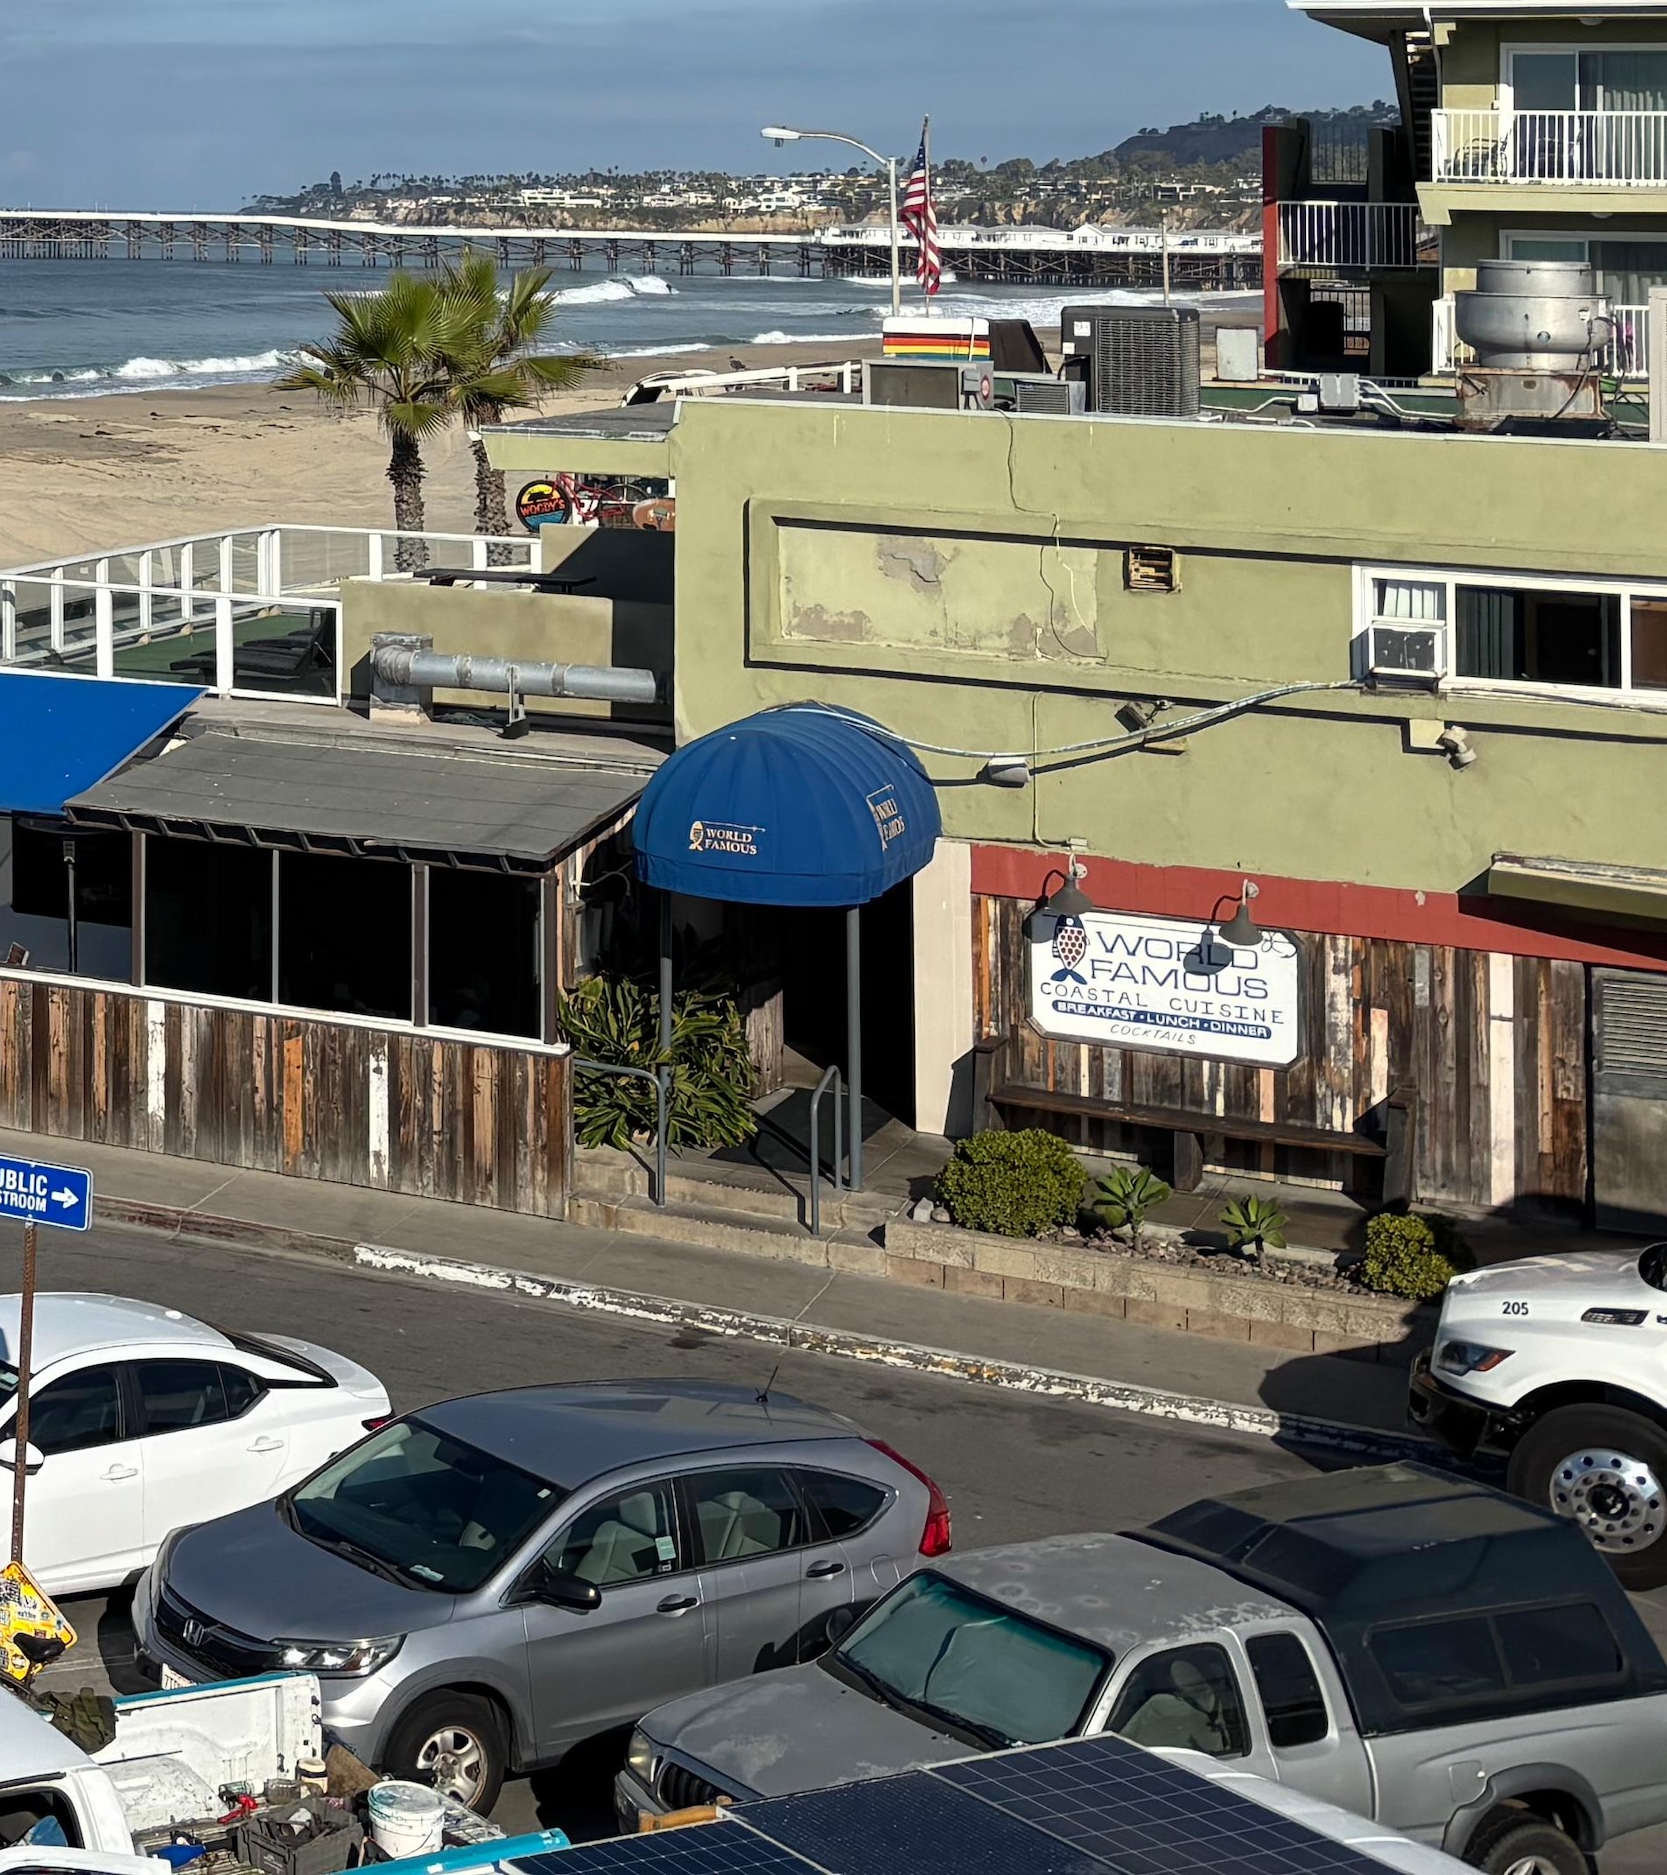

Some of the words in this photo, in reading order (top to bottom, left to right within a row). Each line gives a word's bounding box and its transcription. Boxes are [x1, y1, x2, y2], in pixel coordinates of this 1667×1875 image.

[704, 838, 758, 855] FAMOUS
[705, 827, 753, 844] WORLD
[1096, 930, 1259, 970] WORLD
[1090, 958, 1269, 1000] FAMOUS
[1040, 982, 1149, 1008] COASTAL
[1169, 997, 1285, 1025] CUISINE
[1057, 1001, 1137, 1022] BREAKFAST
[1146, 1012, 1200, 1030] LUNCH
[1210, 1021, 1268, 1038] DINNER
[1110, 1024, 1197, 1045] COCKTAILS
[1502, 1301, 1529, 1316] 205
